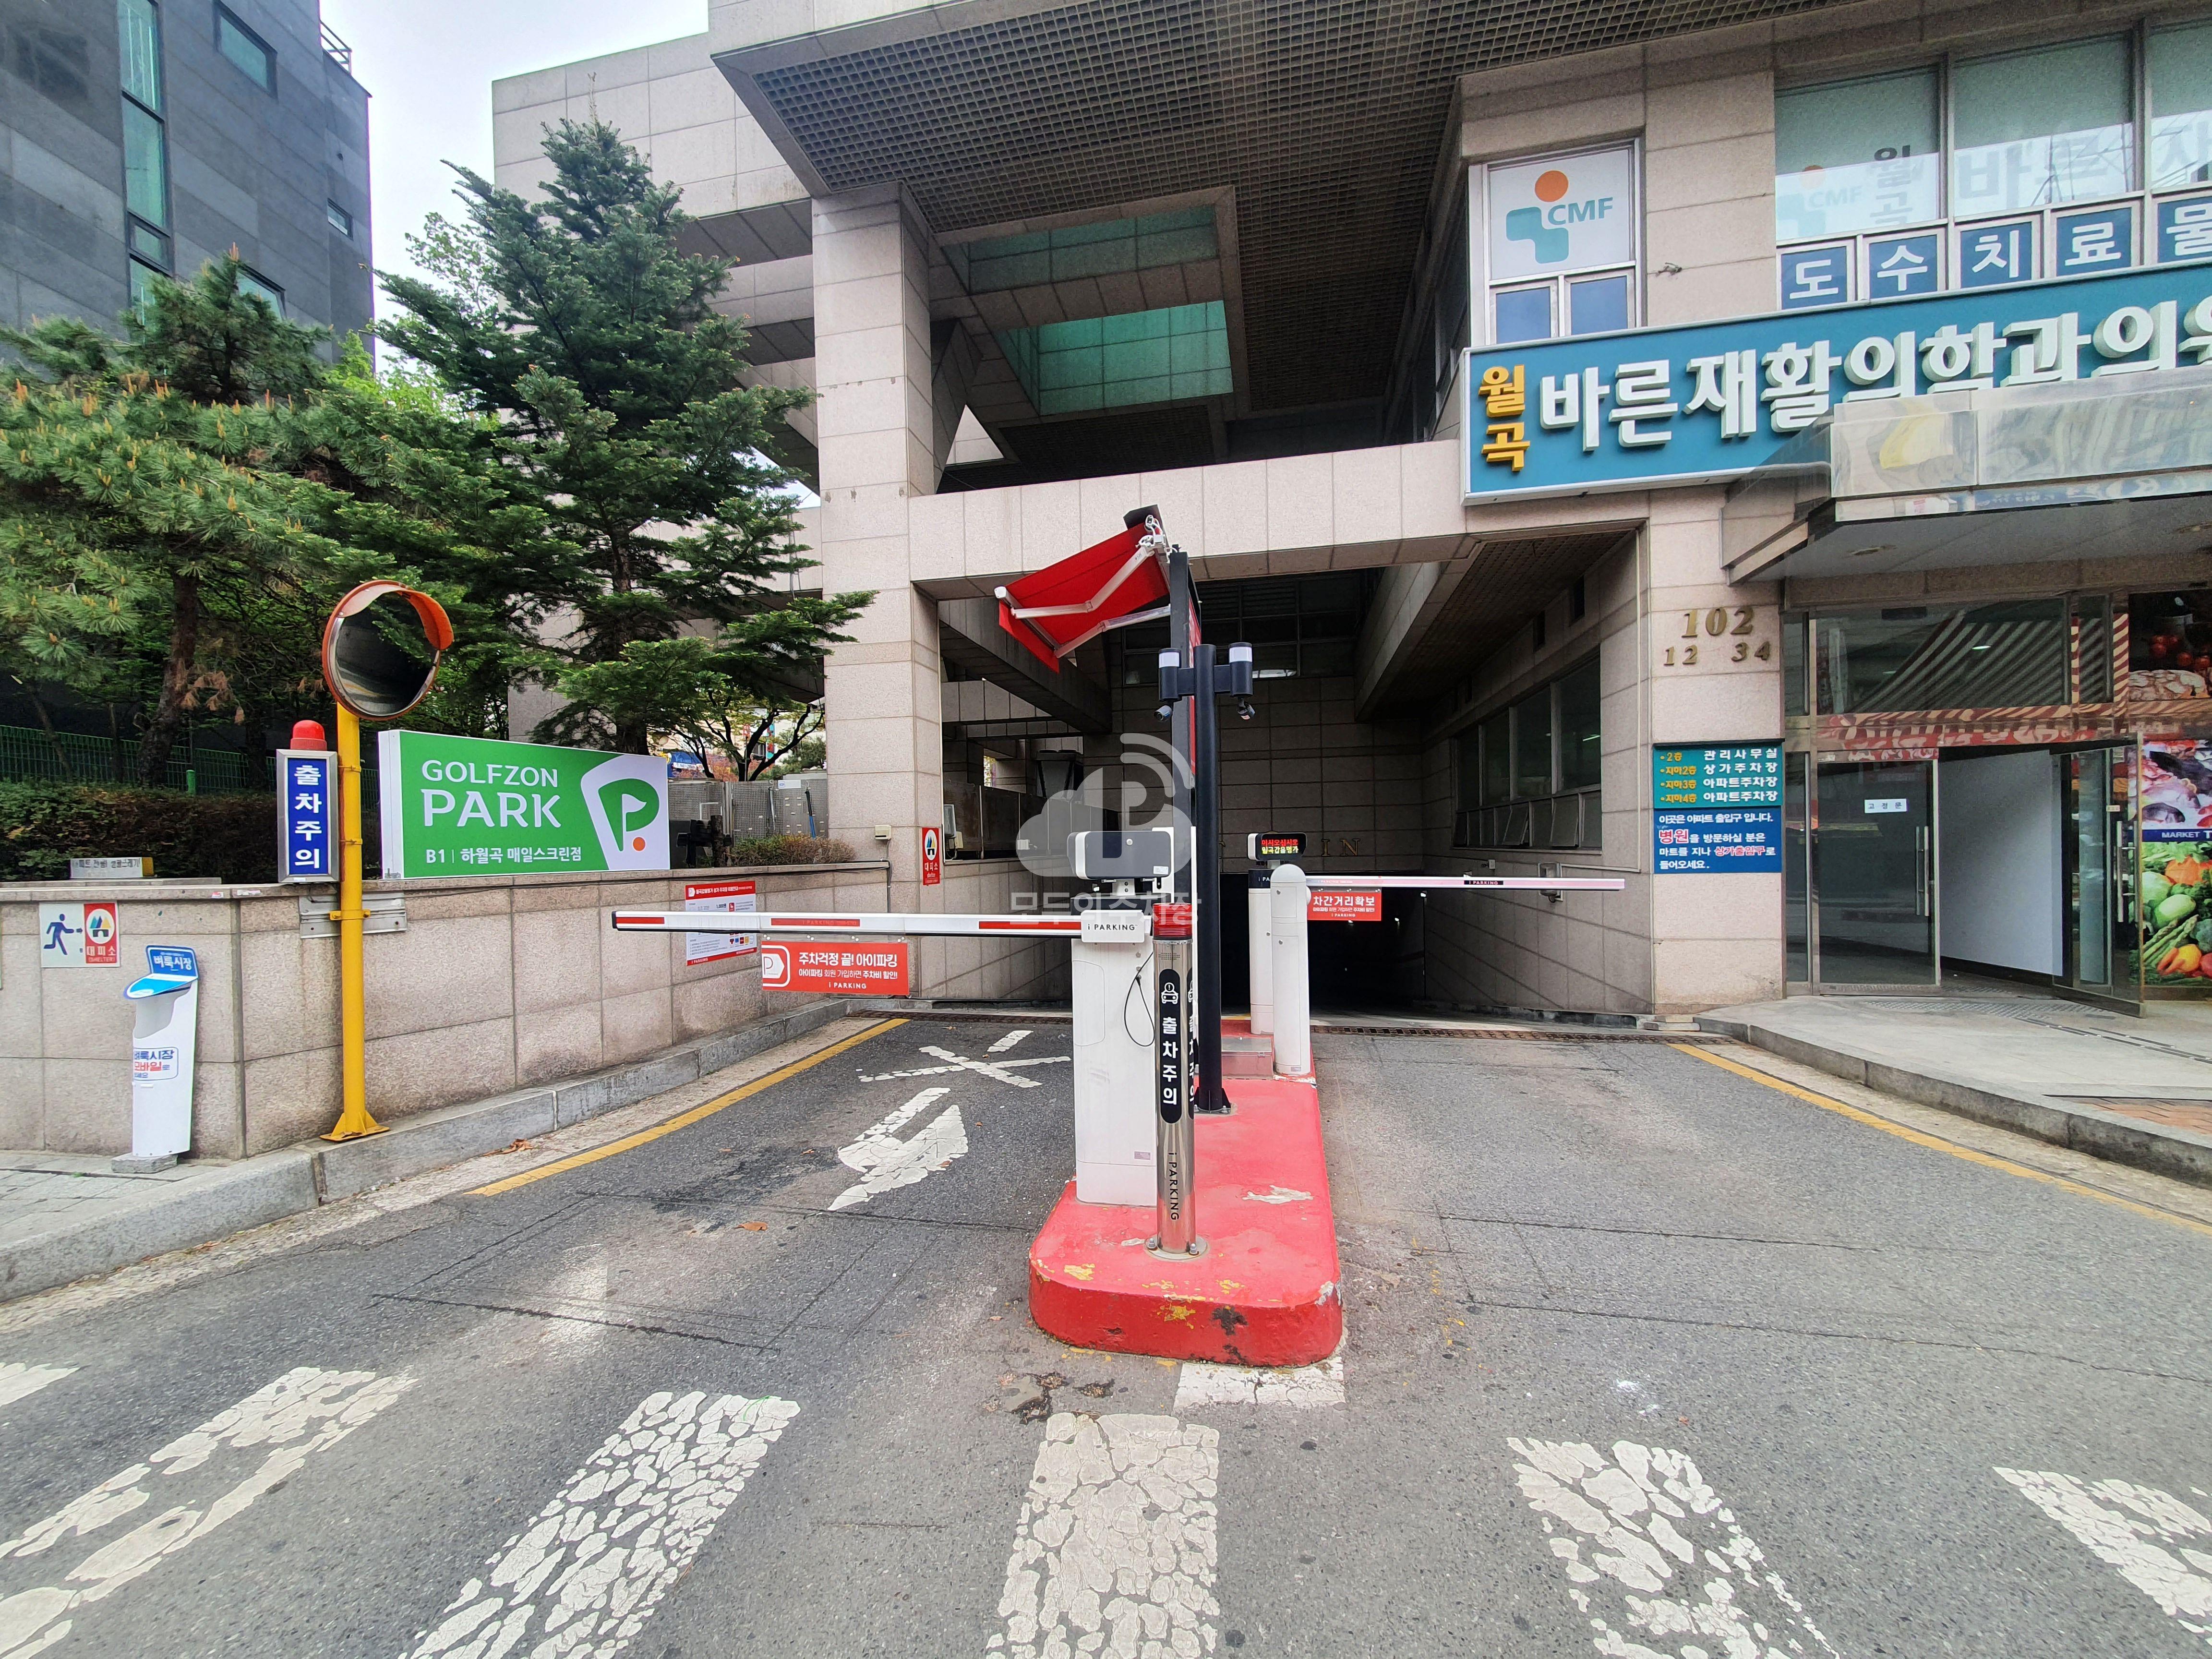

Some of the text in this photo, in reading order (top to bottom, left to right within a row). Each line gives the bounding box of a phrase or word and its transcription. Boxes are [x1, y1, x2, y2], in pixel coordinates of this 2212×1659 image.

[1548, 196, 1613, 225] CMF
[1790, 222, 2122, 300] 도수치료
[1479, 364, 1530, 472] 월곡
[1681, 605, 1755, 638] 102
[1704, 748, 1777, 760] 관리사무실
[422, 759, 558, 788] GOLFZON
[1704, 762, 1778, 775] 상가주차장
[1703, 776, 1778, 788] 아파트주차장
[1703, 791, 1778, 803] 아파트주차장
[294, 764, 323, 869] 출차주의
[421, 789, 562, 828] PARK
[1659, 812, 1774, 824] 이곳은 아파트 출입구 입니다.
[1659, 829, 1766, 844] 병원을 방문하실 분은
[426, 846, 582, 864] B1 하월곡 매일스크린점
[1321, 839, 1360, 857] IN
[1659, 845, 1776, 857] 마트를 지나 상가출입구로
[925, 862, 938, 871] 대피소
[1313, 896, 1375, 906] 차간거리확보
[86, 946, 116, 956] 대피소
[153, 955, 192, 971] 벼룩시장
[799, 952, 898, 968] 주차걱정 끝! 아이파킹
[799, 968, 898, 979] 아이파킹 회원 가입하면 주차비 할인!
[1162, 1017, 1178, 1106] 출차주의
[1169, 1162, 1179, 1220] PARKING
